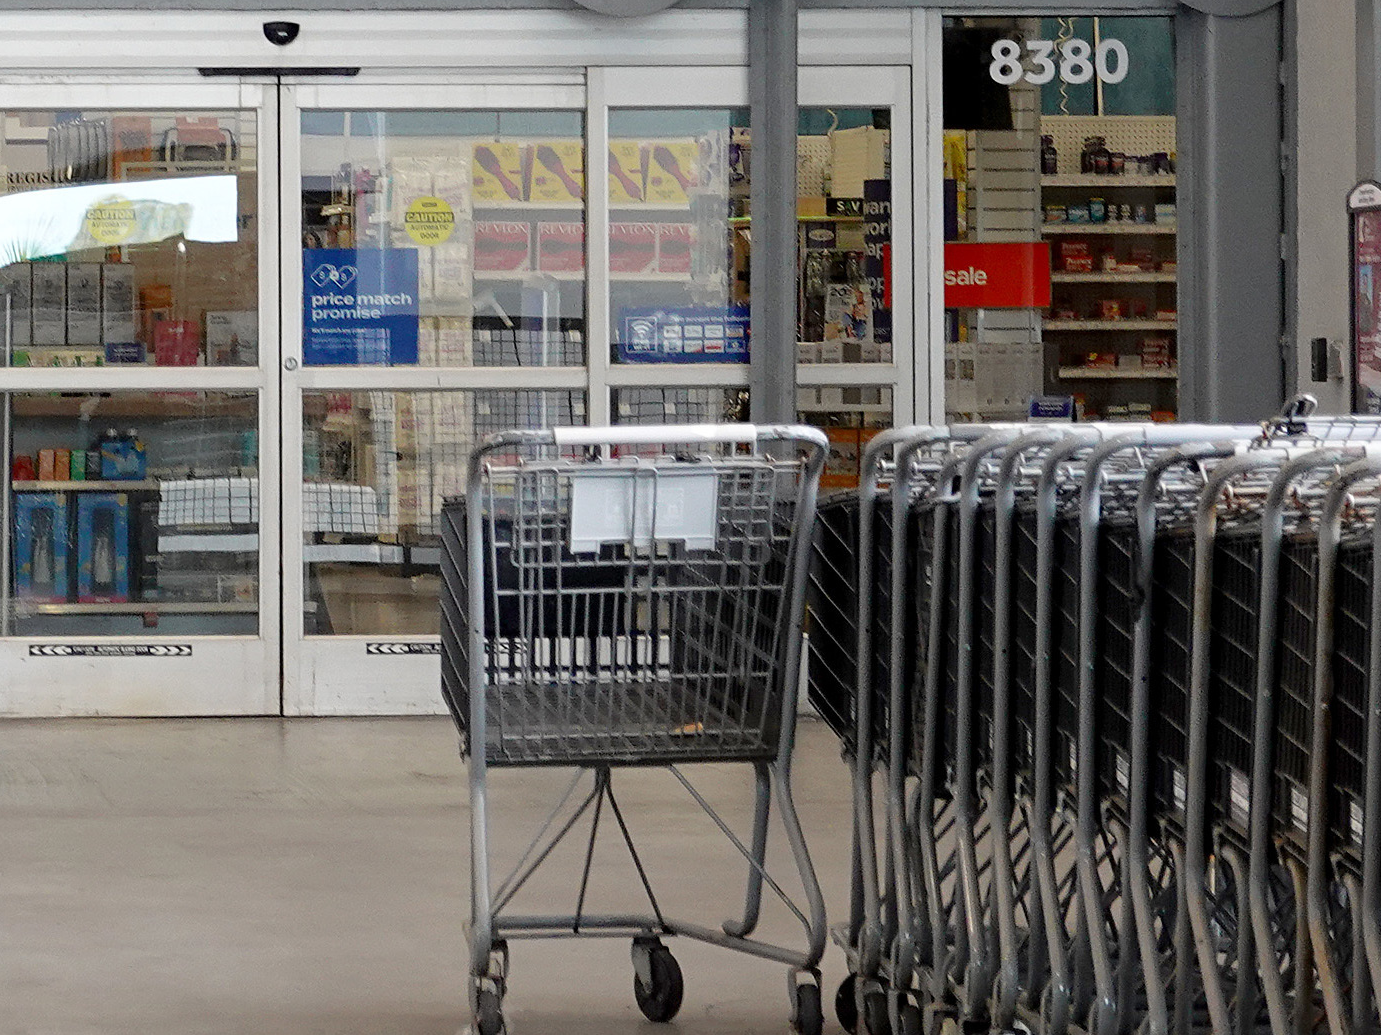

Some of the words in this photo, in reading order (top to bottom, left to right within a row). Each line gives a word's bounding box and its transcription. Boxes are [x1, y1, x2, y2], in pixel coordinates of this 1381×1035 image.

[989, 38, 1129, 85] 8380
[86, 209, 135, 220] CAUTION
[405, 212, 454, 223] CAUTION
[476, 224, 528, 235] REVLON
[944, 266, 988, 286] sale
[311, 293, 353, 308] price
[357, 293, 412, 306] match
[311, 307, 382, 323] promise
